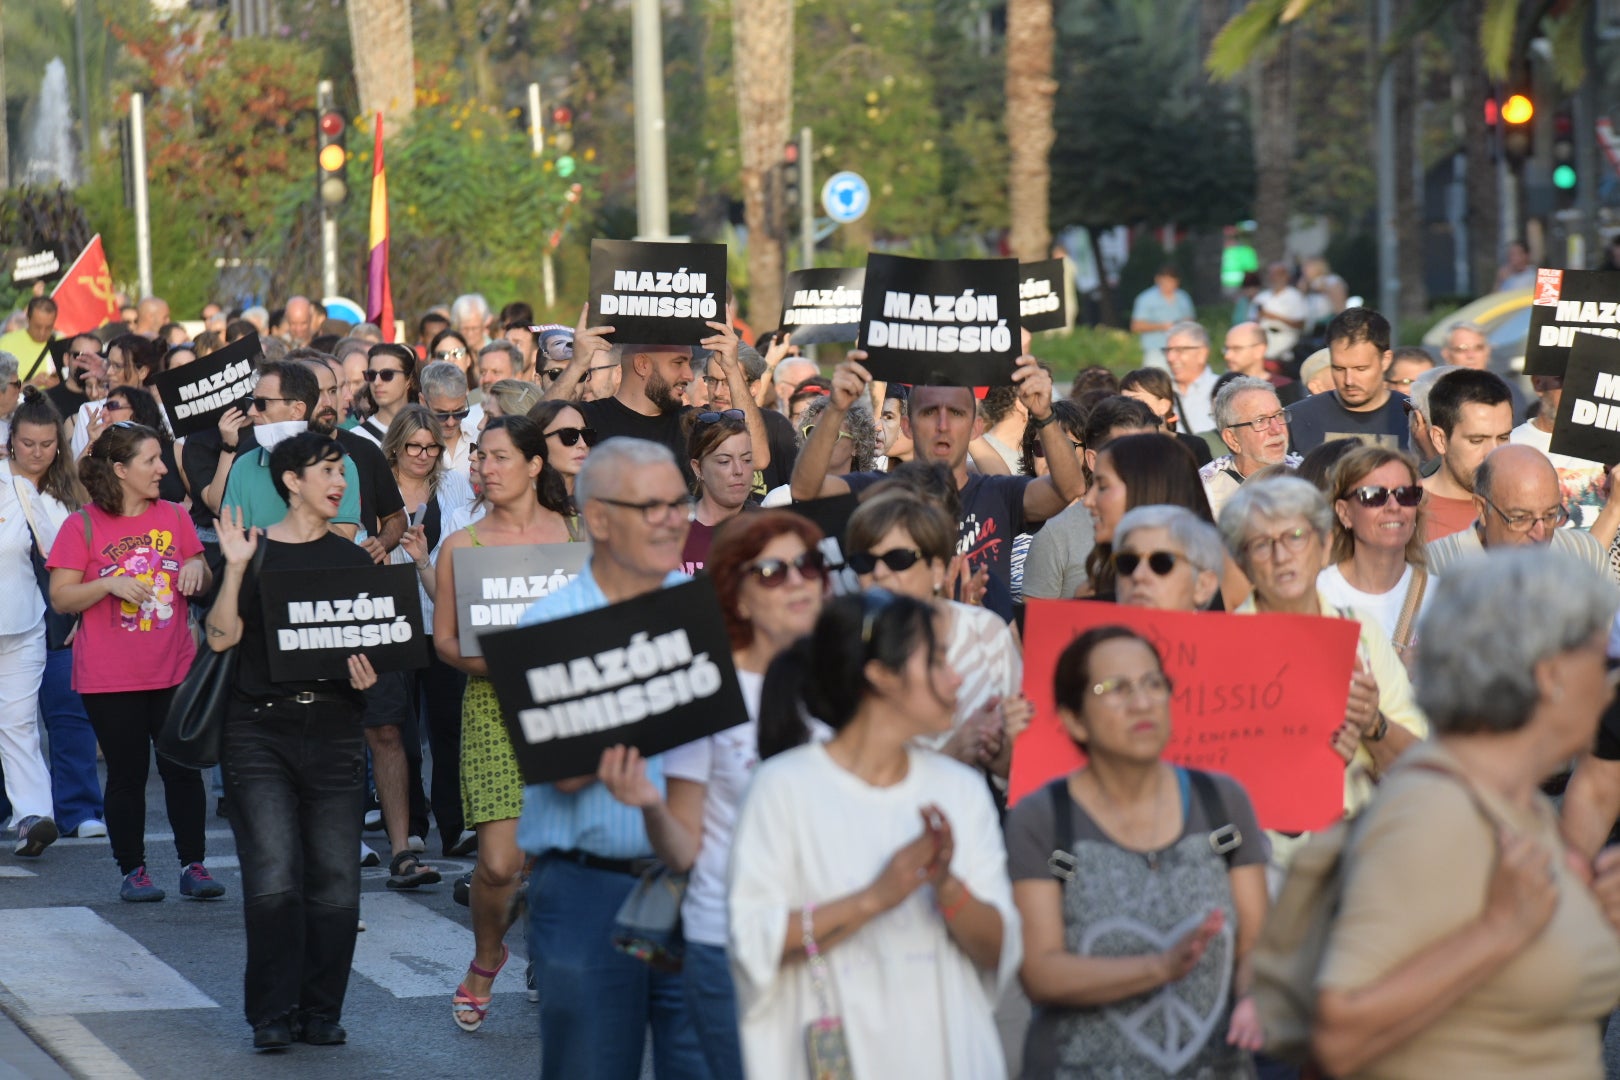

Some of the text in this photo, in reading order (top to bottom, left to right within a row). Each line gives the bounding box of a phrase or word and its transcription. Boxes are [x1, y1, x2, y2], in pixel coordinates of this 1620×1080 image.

[614, 267, 707, 293] MAZÓN
[792, 285, 862, 306] MAZÓN
[600, 292, 717, 319] DIMISSIÓ
[883, 289, 998, 322] MAZÓN
[867, 319, 1012, 353] DIMISSIÓ
[178, 358, 252, 402] MAZÓN
[482, 568, 579, 600] MAZÓ
[288, 592, 396, 624] MAZÓN
[277, 615, 413, 651] DIMISSIÓ
[525, 628, 693, 704] MAZÓN
[518, 651, 722, 745] DIMISSIÓ
